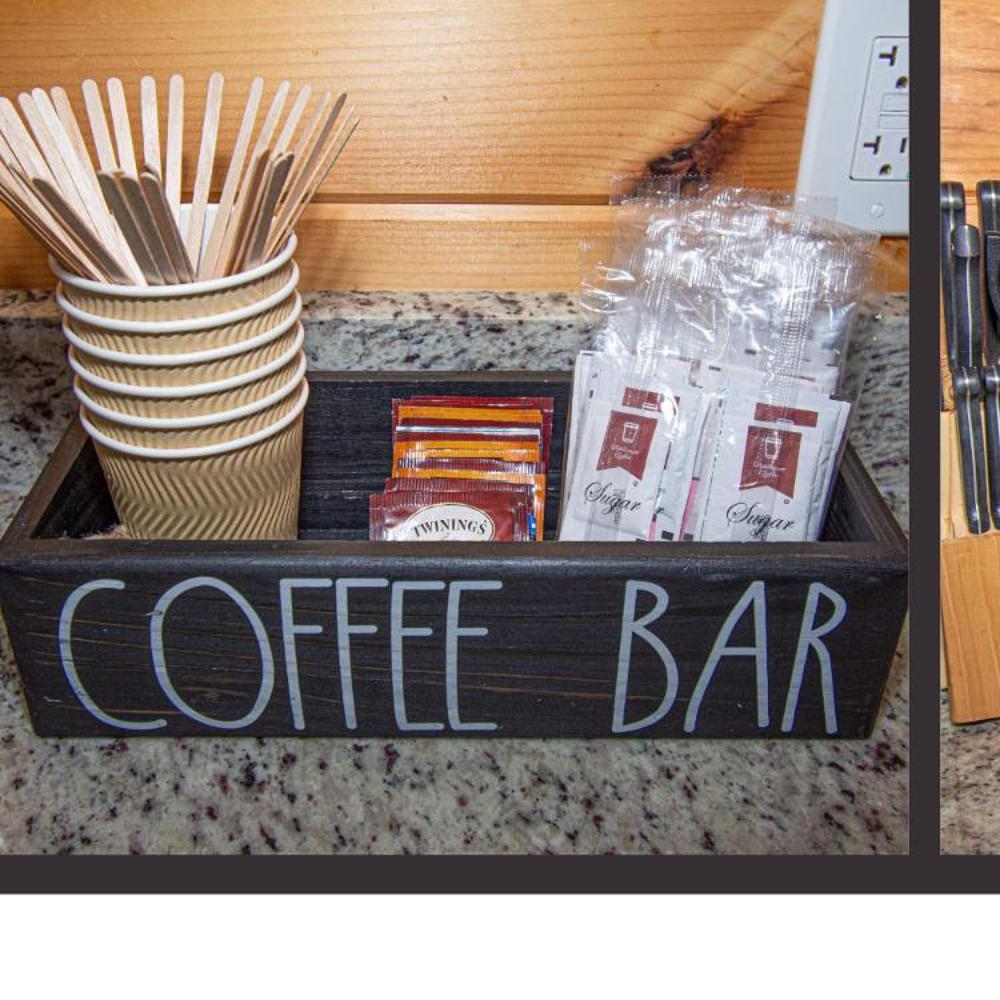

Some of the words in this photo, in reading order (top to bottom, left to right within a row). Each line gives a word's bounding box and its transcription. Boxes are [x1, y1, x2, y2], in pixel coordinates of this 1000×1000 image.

[583, 481, 642, 516] Sugar
[410, 518, 489, 538] TWININGS
[725, 501, 795, 538] Sugar
[58, 575, 504, 732] COFFEE
[611, 579, 849, 734] BAR
